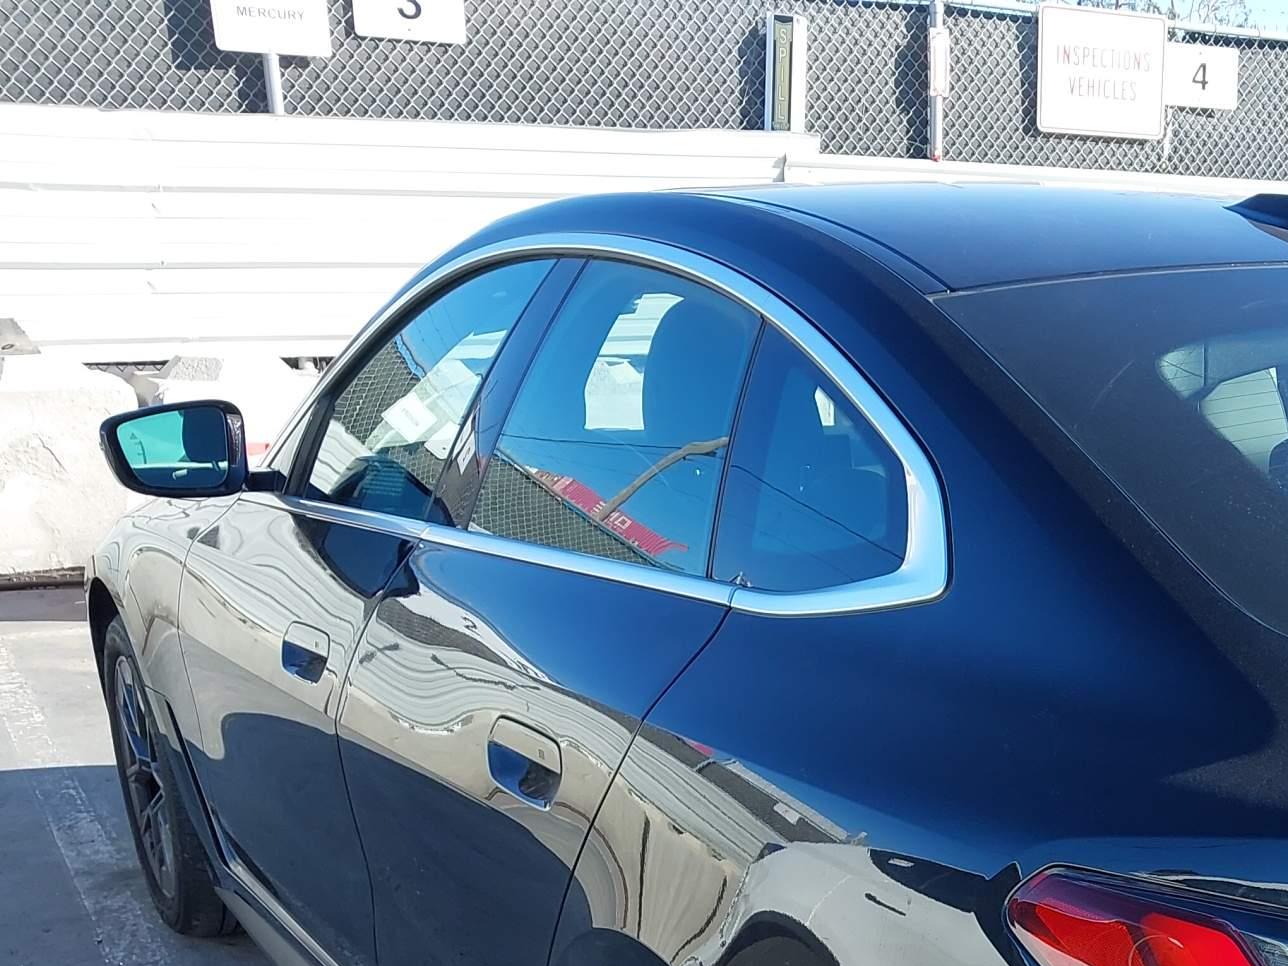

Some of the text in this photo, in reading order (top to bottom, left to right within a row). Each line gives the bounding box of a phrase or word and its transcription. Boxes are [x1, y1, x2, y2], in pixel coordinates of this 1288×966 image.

[236, 5, 304, 21] MERCURY
[1056, 45, 1151, 73] INSPECTIONS
[777, 28, 788, 120] SPILL
[1192, 63, 1209, 91] 4
[1068, 77, 1137, 102] VEHICLES
